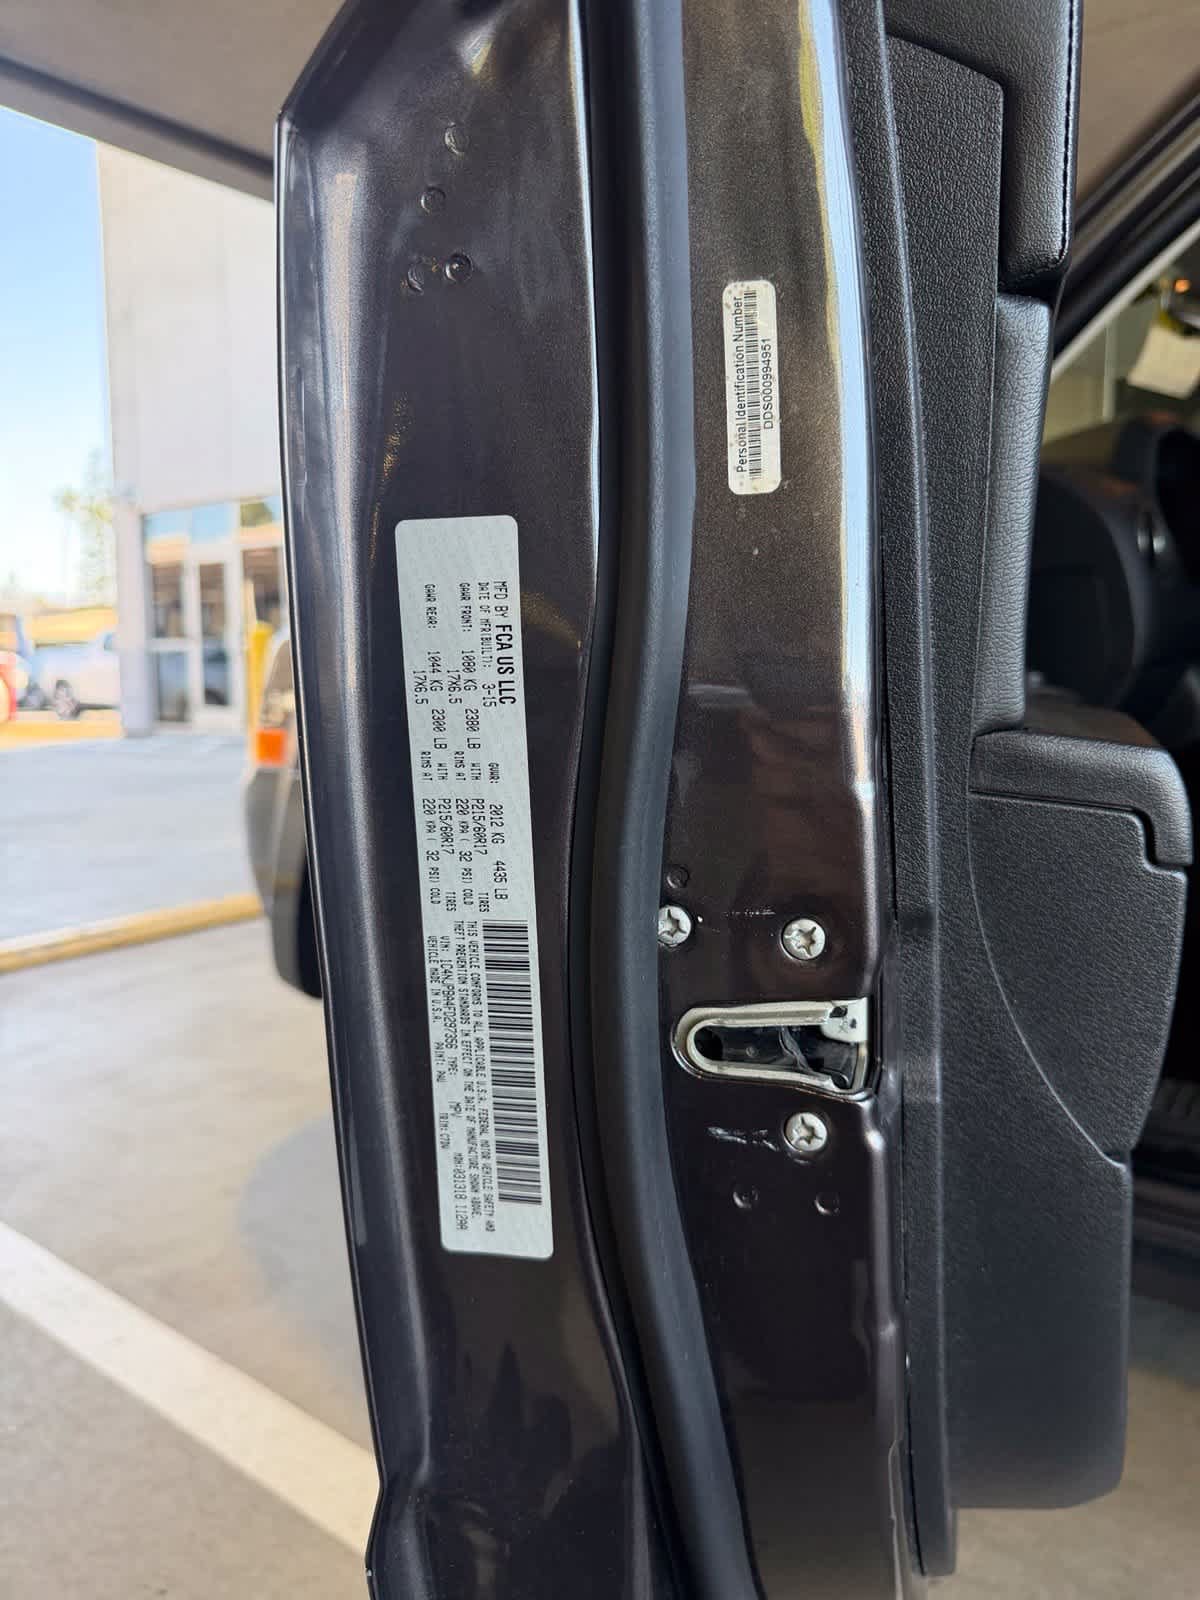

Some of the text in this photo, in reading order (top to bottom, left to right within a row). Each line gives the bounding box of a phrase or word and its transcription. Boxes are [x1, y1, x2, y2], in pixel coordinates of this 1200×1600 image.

[731, 296, 747, 472] Personal Identification Number
[762, 337, 774, 429] DDS000994951
[478, 582, 490, 600] DATE
[480, 605, 490, 615] OF
[494, 581, 516, 704] MFD BY FCA US LLC
[413, 670, 428, 705] 17X6.5
[447, 669, 462, 704] 17X6.5
[483, 683, 496, 707] 3-15
[425, 584, 456, 911] GAWR REAR: 1044 KG 2300 LB WITH P215/60R17 TIRES
[460, 582, 489, 913] GAWR FRONT: 1080 KG 2380 LB WITH P215/60R17 TIRES
[421, 751, 431, 768] RIMS
[455, 751, 465, 768] RIMS
[423, 772, 432, 781] AT
[456, 772, 465, 781] AT
[489, 762, 500, 784] GVWR:
[423, 798, 436, 815] 220
[456, 798, 470, 815] 220
[490, 804, 504, 827] 2012
[426, 820, 436, 833] KPA
[459, 820, 469, 833] KPA
[491, 832, 505, 844] KG
[427, 850, 439, 862] 32
[459, 850, 472, 862] 32
[461, 868, 472, 884] PSI)
[493, 860, 507, 883] 4435
[430, 888, 441, 905] COLD
[463, 889, 474, 905] COLD
[494, 888, 508, 900] LB
[454, 921, 465, 940] THEFT
[468, 921, 478, 936] THIS
[428, 935, 439, 964] VEHICLE
[469, 940, 480, 969] VEHICLE
[456, 944, 468, 985] PREVENTION
[430, 968, 441, 984] MADE
[471, 972, 482, 1005] CONFORMS
[440, 936, 451, 951] VIN:
[448, 1056, 459, 1075] TYPE:
[458, 988, 470, 1025] STANDARDS
[473, 1010, 483, 1018] TO
[473, 1021, 484, 1033] ALL
[435, 1042, 446, 1065] PAINT:
[462, 1040, 473, 1064] EFFECT
[474, 1037, 486, 1077] APPLICABLE
[463, 1067, 473, 1077] ON
[464, 1081, 474, 1092] THE
[465, 1095, 475, 1111] DATE
[466, 1115, 476, 1123] OF
[478, 1108, 489, 1136] FEDERAL
[467, 1127, 479, 1169] MANUFACTURE
[480, 1140, 491, 1159] MOTOR
[470, 1173, 480, 1193] SHOWN
[482, 1163, 492, 1190] VEHICLE
[483, 1193, 494, 1216] SAFETY
